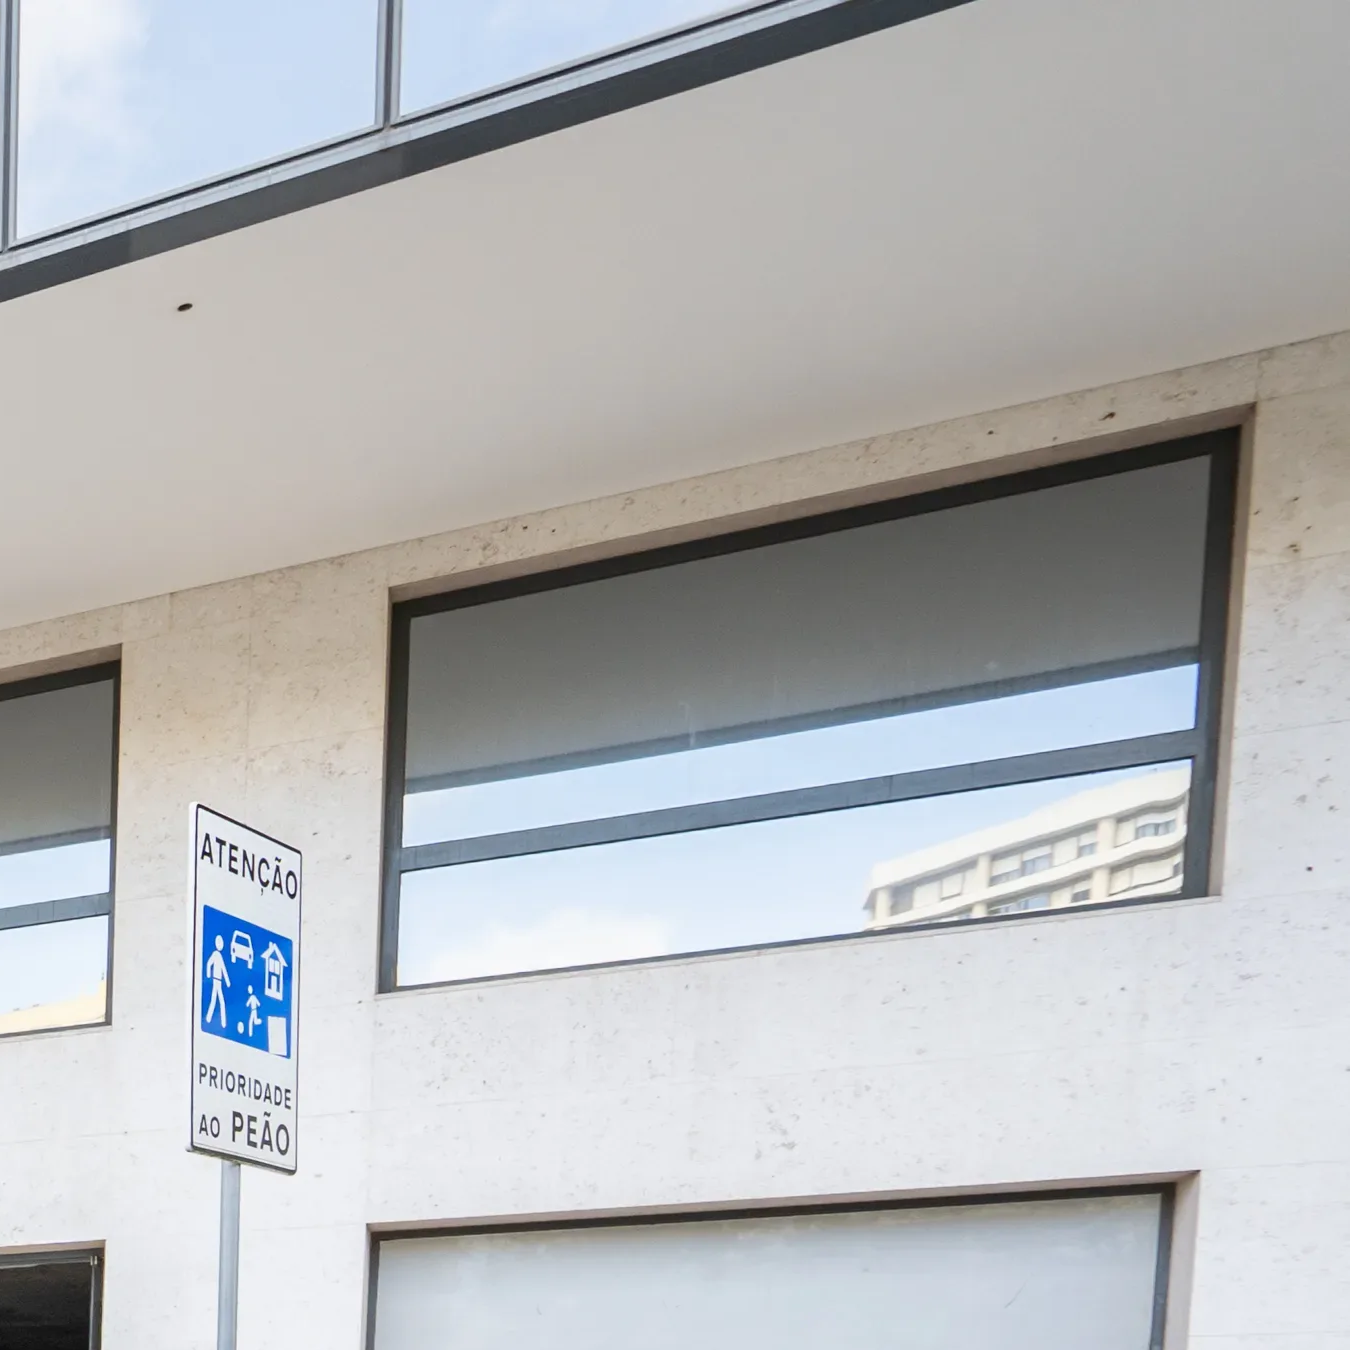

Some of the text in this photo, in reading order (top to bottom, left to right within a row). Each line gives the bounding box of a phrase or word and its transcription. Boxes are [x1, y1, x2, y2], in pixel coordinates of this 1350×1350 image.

[200, 832, 298, 900] ATENÇÃO
[198, 1062, 291, 1109] PRIORIDADE
[198, 1110, 290, 1156] AO PEÃO
